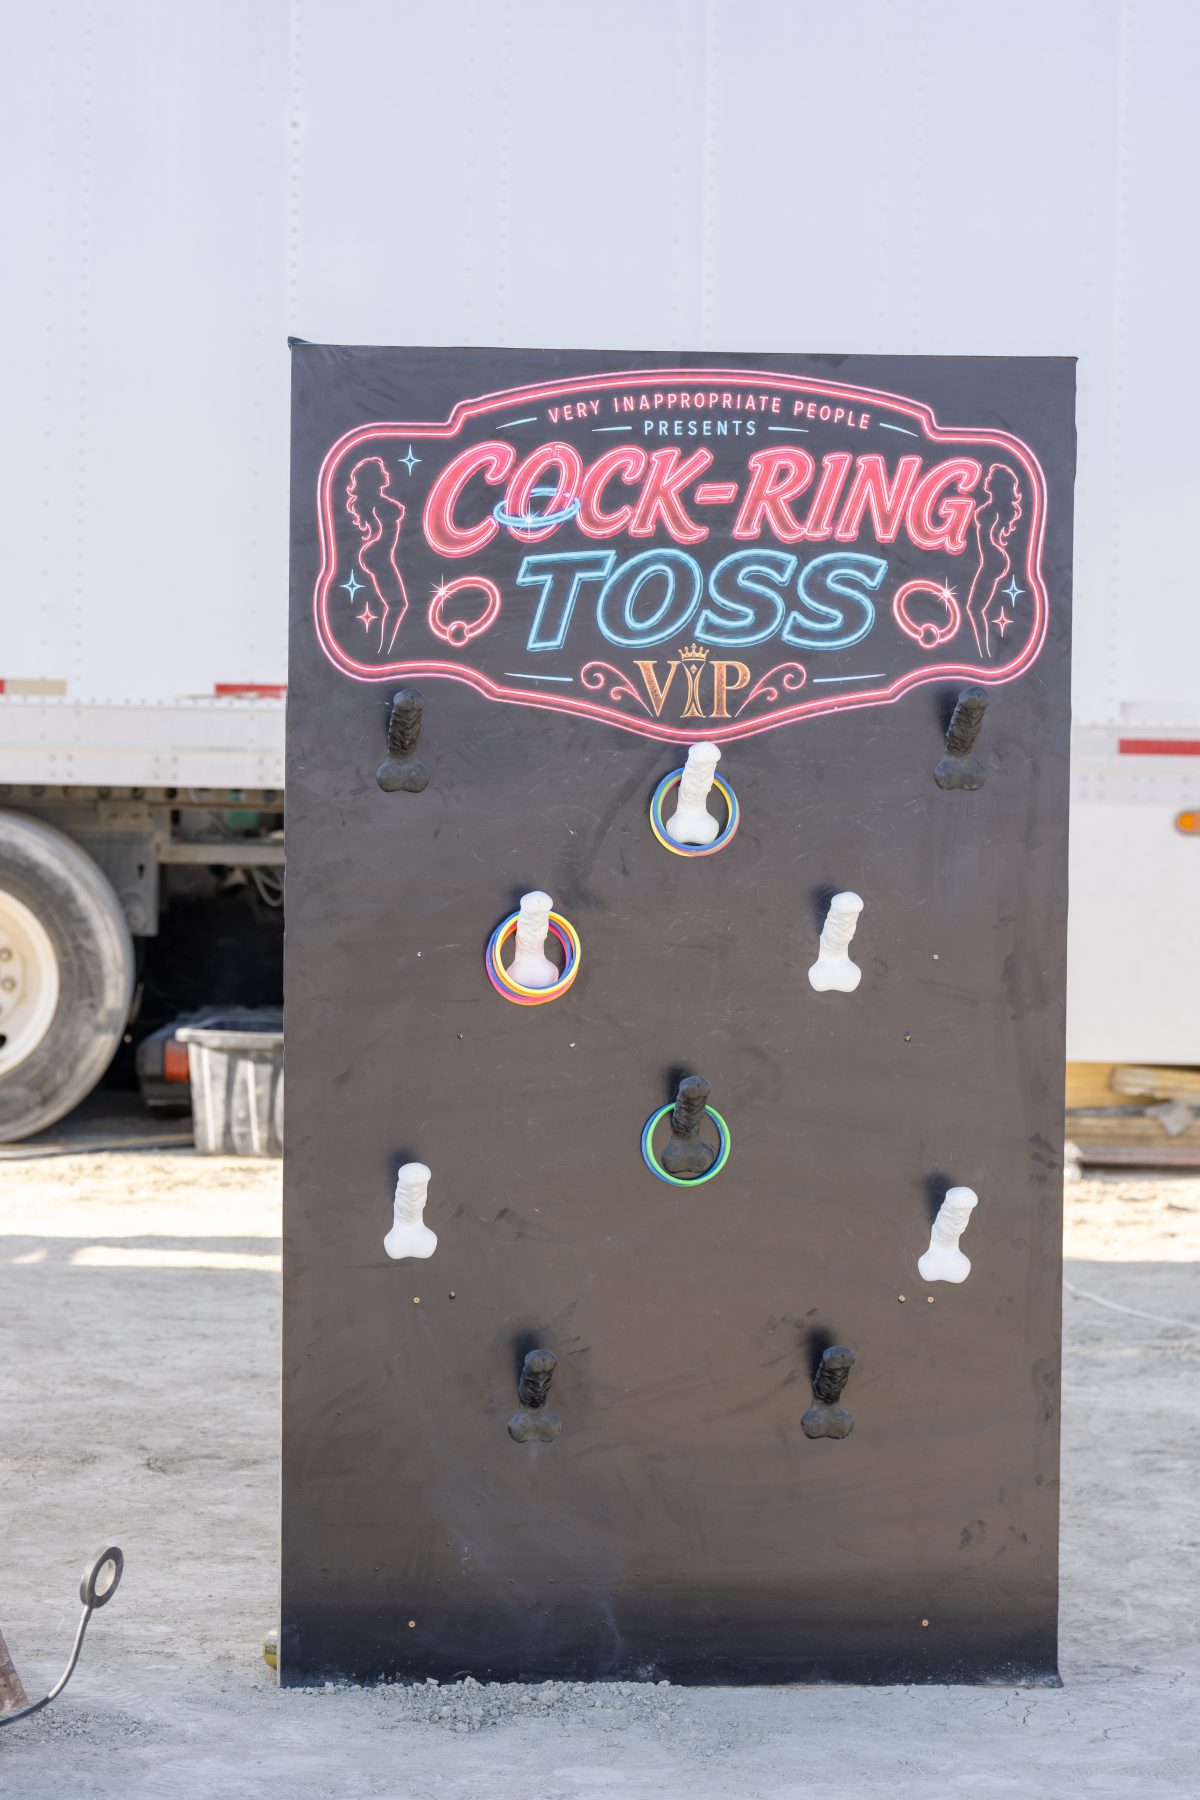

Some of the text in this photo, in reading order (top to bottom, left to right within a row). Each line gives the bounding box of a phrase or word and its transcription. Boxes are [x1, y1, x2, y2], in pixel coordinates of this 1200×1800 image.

[547, 393, 873, 430] VERY INAPPROPRIATE PEOPLE
[643, 420, 757, 437] PRESENTS
[422, 440, 985, 556] COCK-RING
[515, 548, 889, 653] TOSS
[632, 659, 752, 720] VIP
